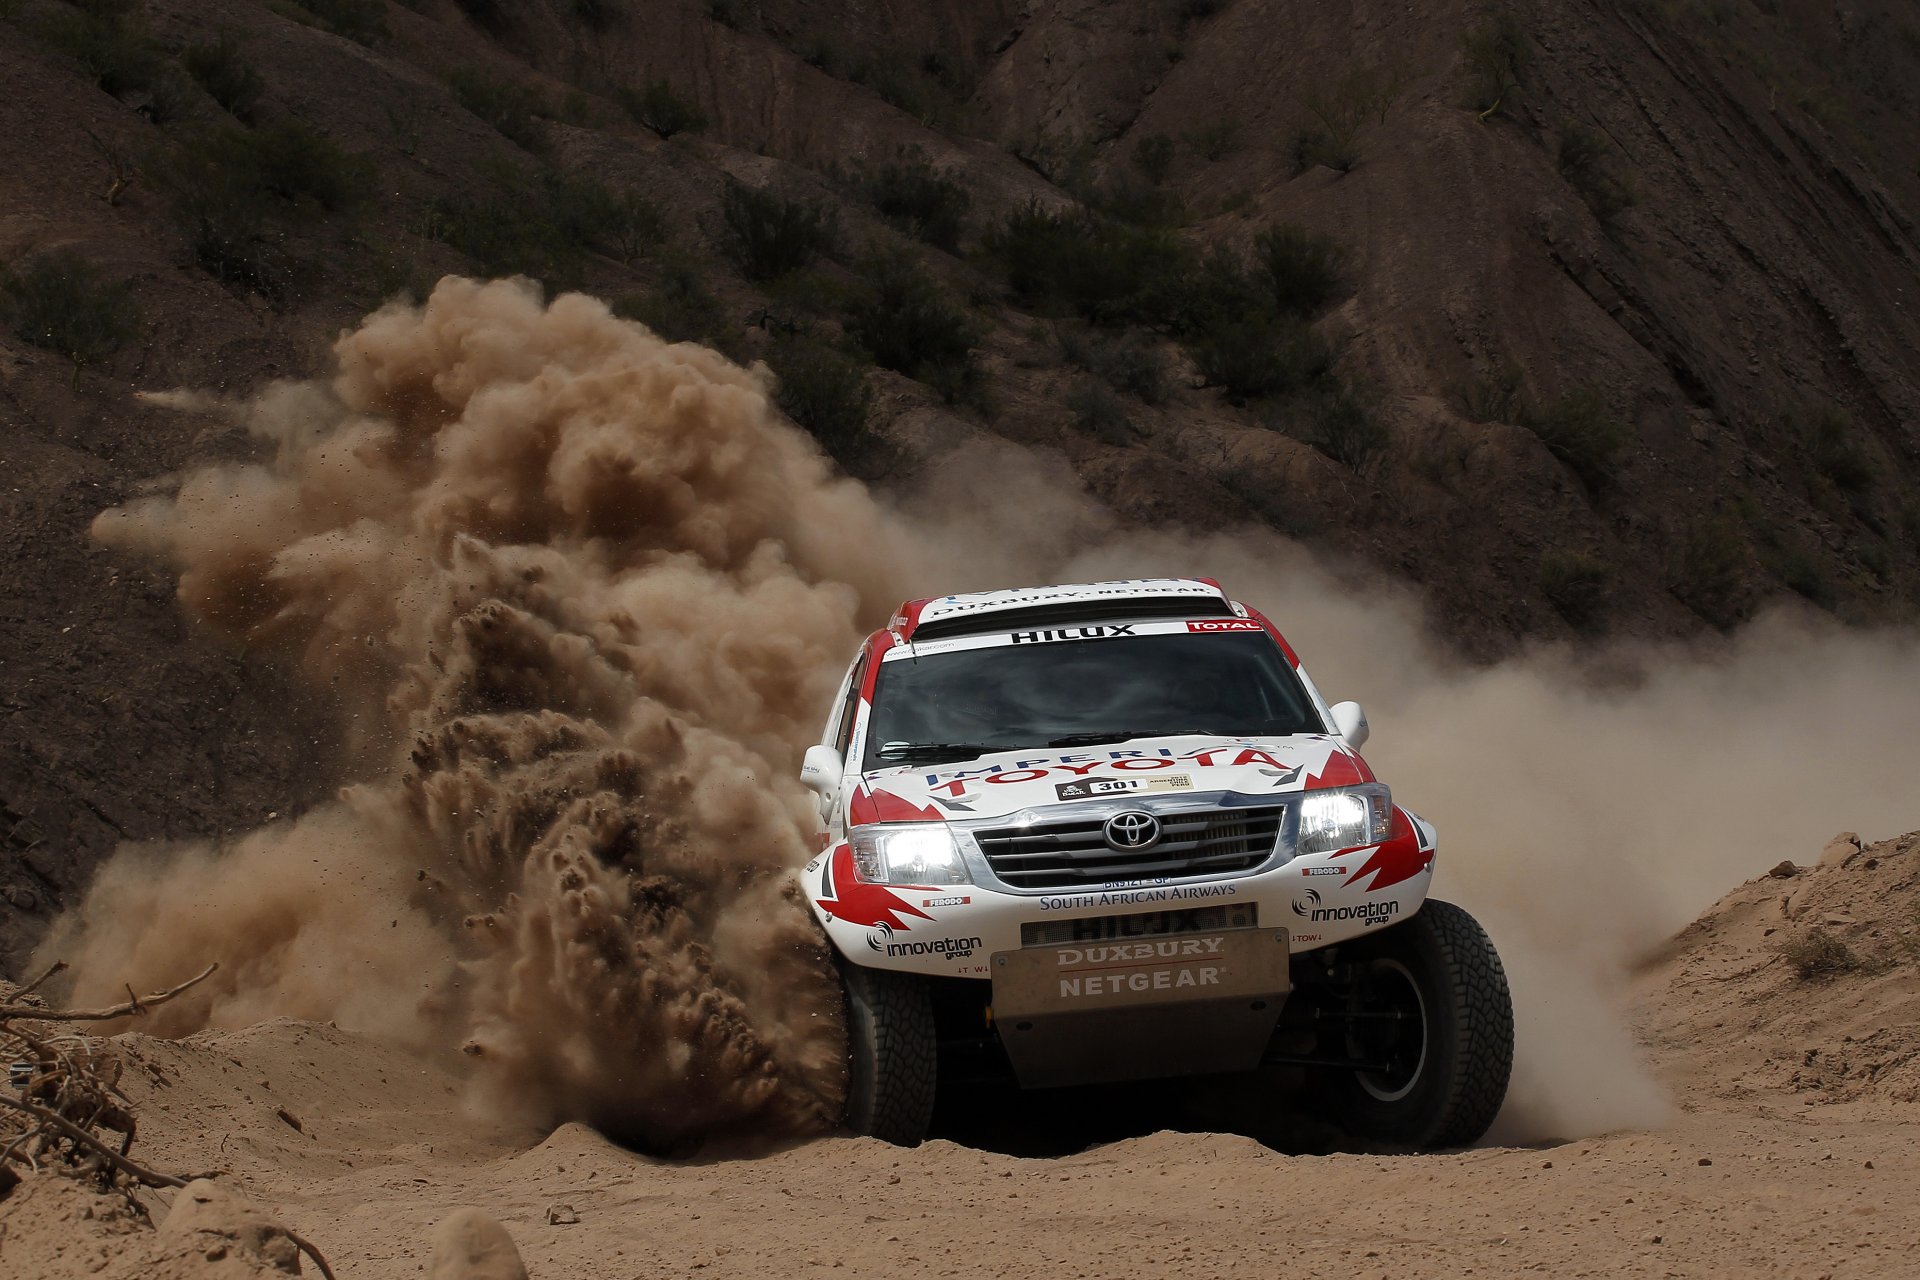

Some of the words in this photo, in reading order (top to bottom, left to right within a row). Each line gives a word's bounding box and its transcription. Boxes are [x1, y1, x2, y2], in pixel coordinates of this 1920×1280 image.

[1010, 624, 1136, 644] HILUX
[1188, 622, 1260, 630] TOTAL
[930, 749, 1293, 797] TOYOTA
[1098, 780, 1138, 791] 301
[1308, 867, 1340, 875] FERODO
[930, 897, 963, 907] FERODO
[1040, 896, 1094, 911] SOUTH
[1099, 892, 1166, 906] AFRICAN
[1170, 884, 1236, 900] AIRWAYS
[1311, 900, 1399, 921] innovation
[1365, 915, 1389, 926] group
[887, 937, 983, 957] innovation
[945, 950, 973, 960] group
[1057, 937, 1225, 966] DUXBURY
[1060, 967, 1220, 997] NETGEAR
